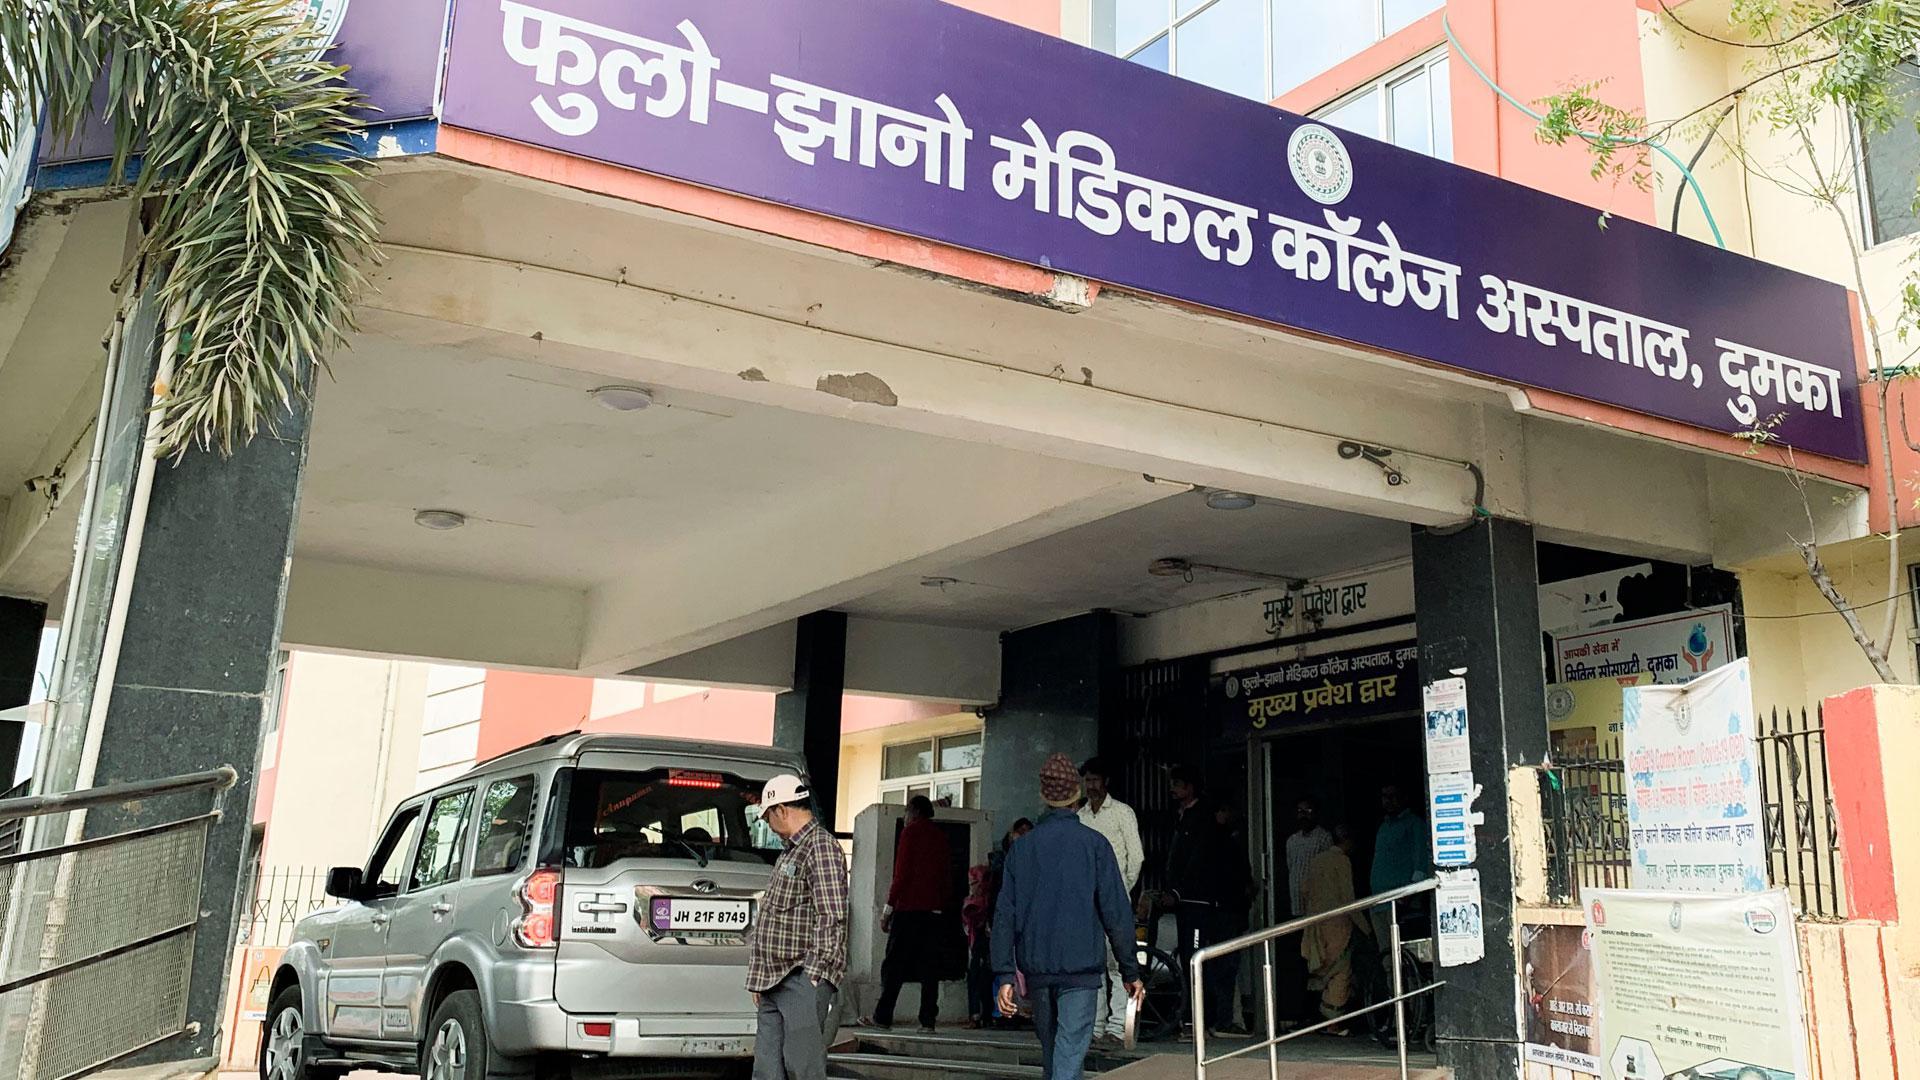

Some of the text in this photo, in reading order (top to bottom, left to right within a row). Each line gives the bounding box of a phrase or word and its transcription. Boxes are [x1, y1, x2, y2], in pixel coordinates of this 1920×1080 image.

[500, 0, 973, 192] फुलो-झानो
[989, 117, 1258, 267] मेडिकल
[1268, 208, 1462, 320] कॉलेज
[1475, 273, 1704, 389] अस्पताल,
[1714, 337, 1843, 426] दुमका
[1341, 582, 1368, 616] द्वार
[1563, 638, 1620, 660] आपकी सेवा में
[1286, 663, 1318, 683] मेडिकल
[1320, 656, 1349, 676] कॉलेज
[1248, 692, 1298, 729] मुख्य
[1302, 678, 1353, 714] प्रवेश
[1358, 674, 1398, 704] द्वार
[675, 911, 690, 922] JH
[694, 911, 714, 923] 21F
[718, 911, 746, 923] 8749
